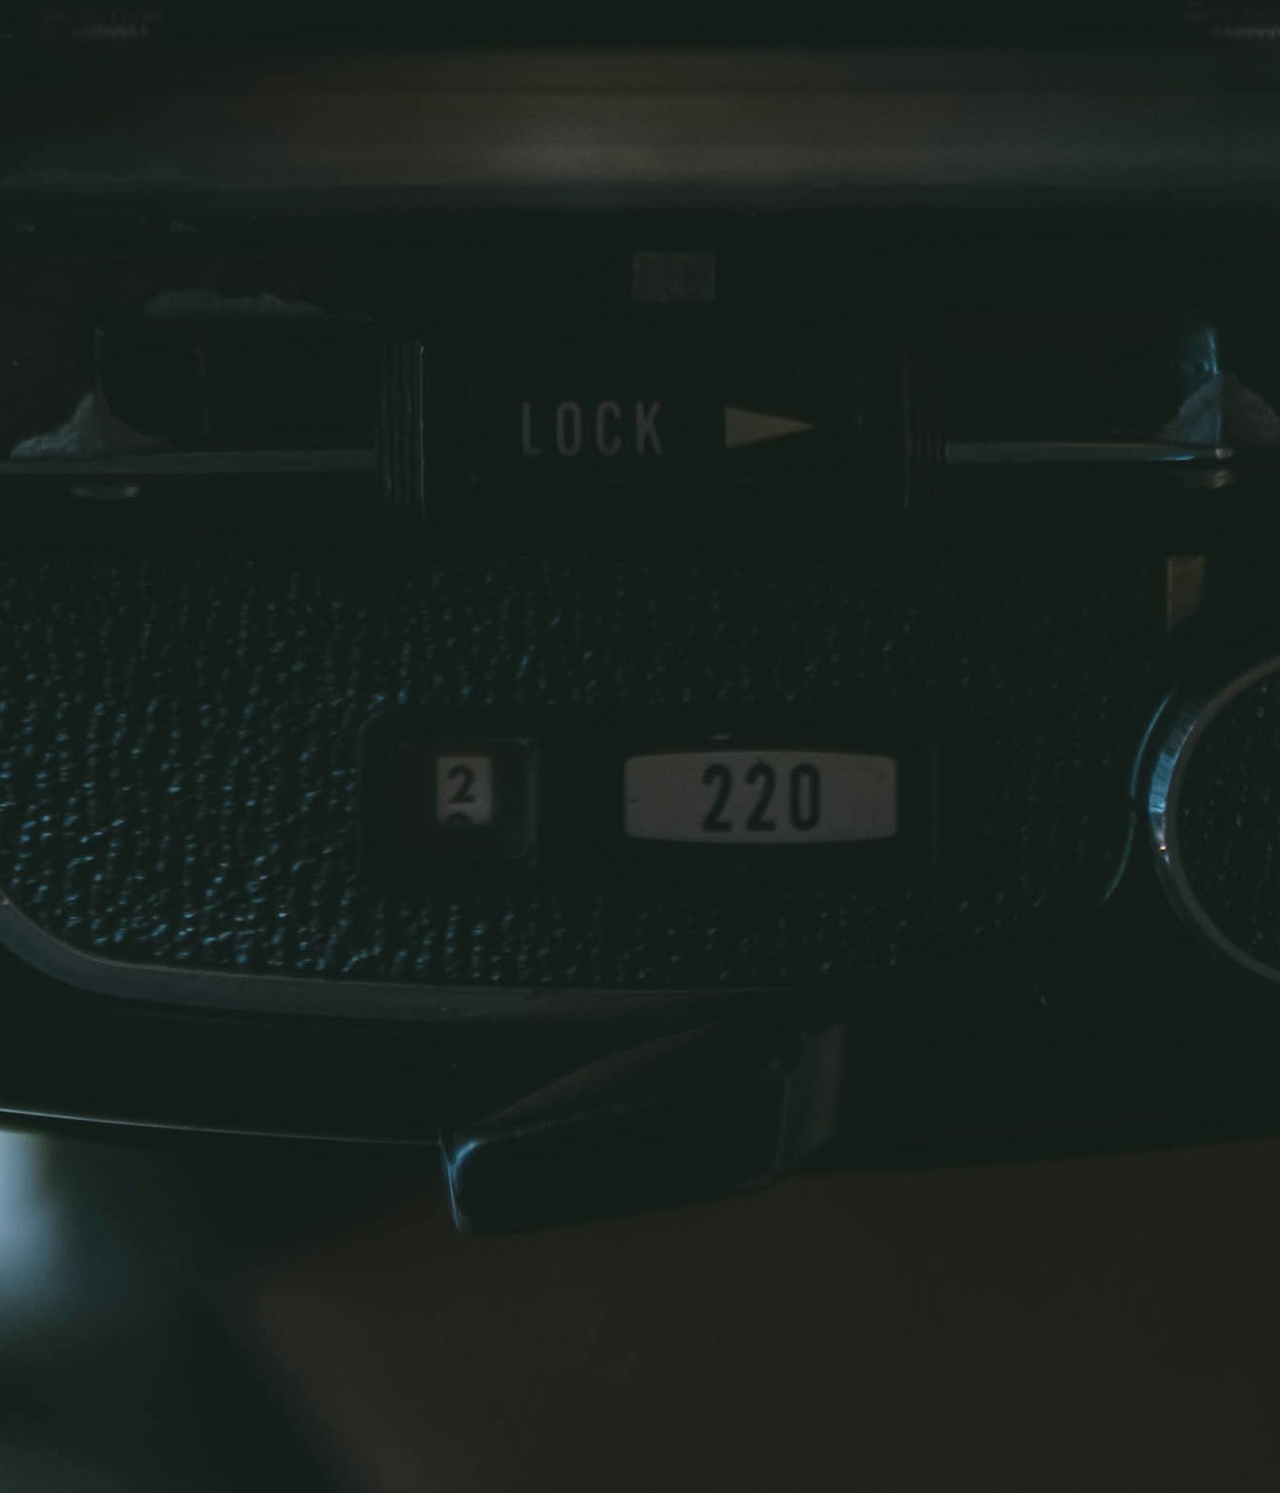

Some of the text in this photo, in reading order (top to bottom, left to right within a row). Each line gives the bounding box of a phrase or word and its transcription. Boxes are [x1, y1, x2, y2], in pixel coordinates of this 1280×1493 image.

[520, 400, 665, 458] LOCK
[447, 763, 478, 805] 2
[701, 761, 821, 833] 220
